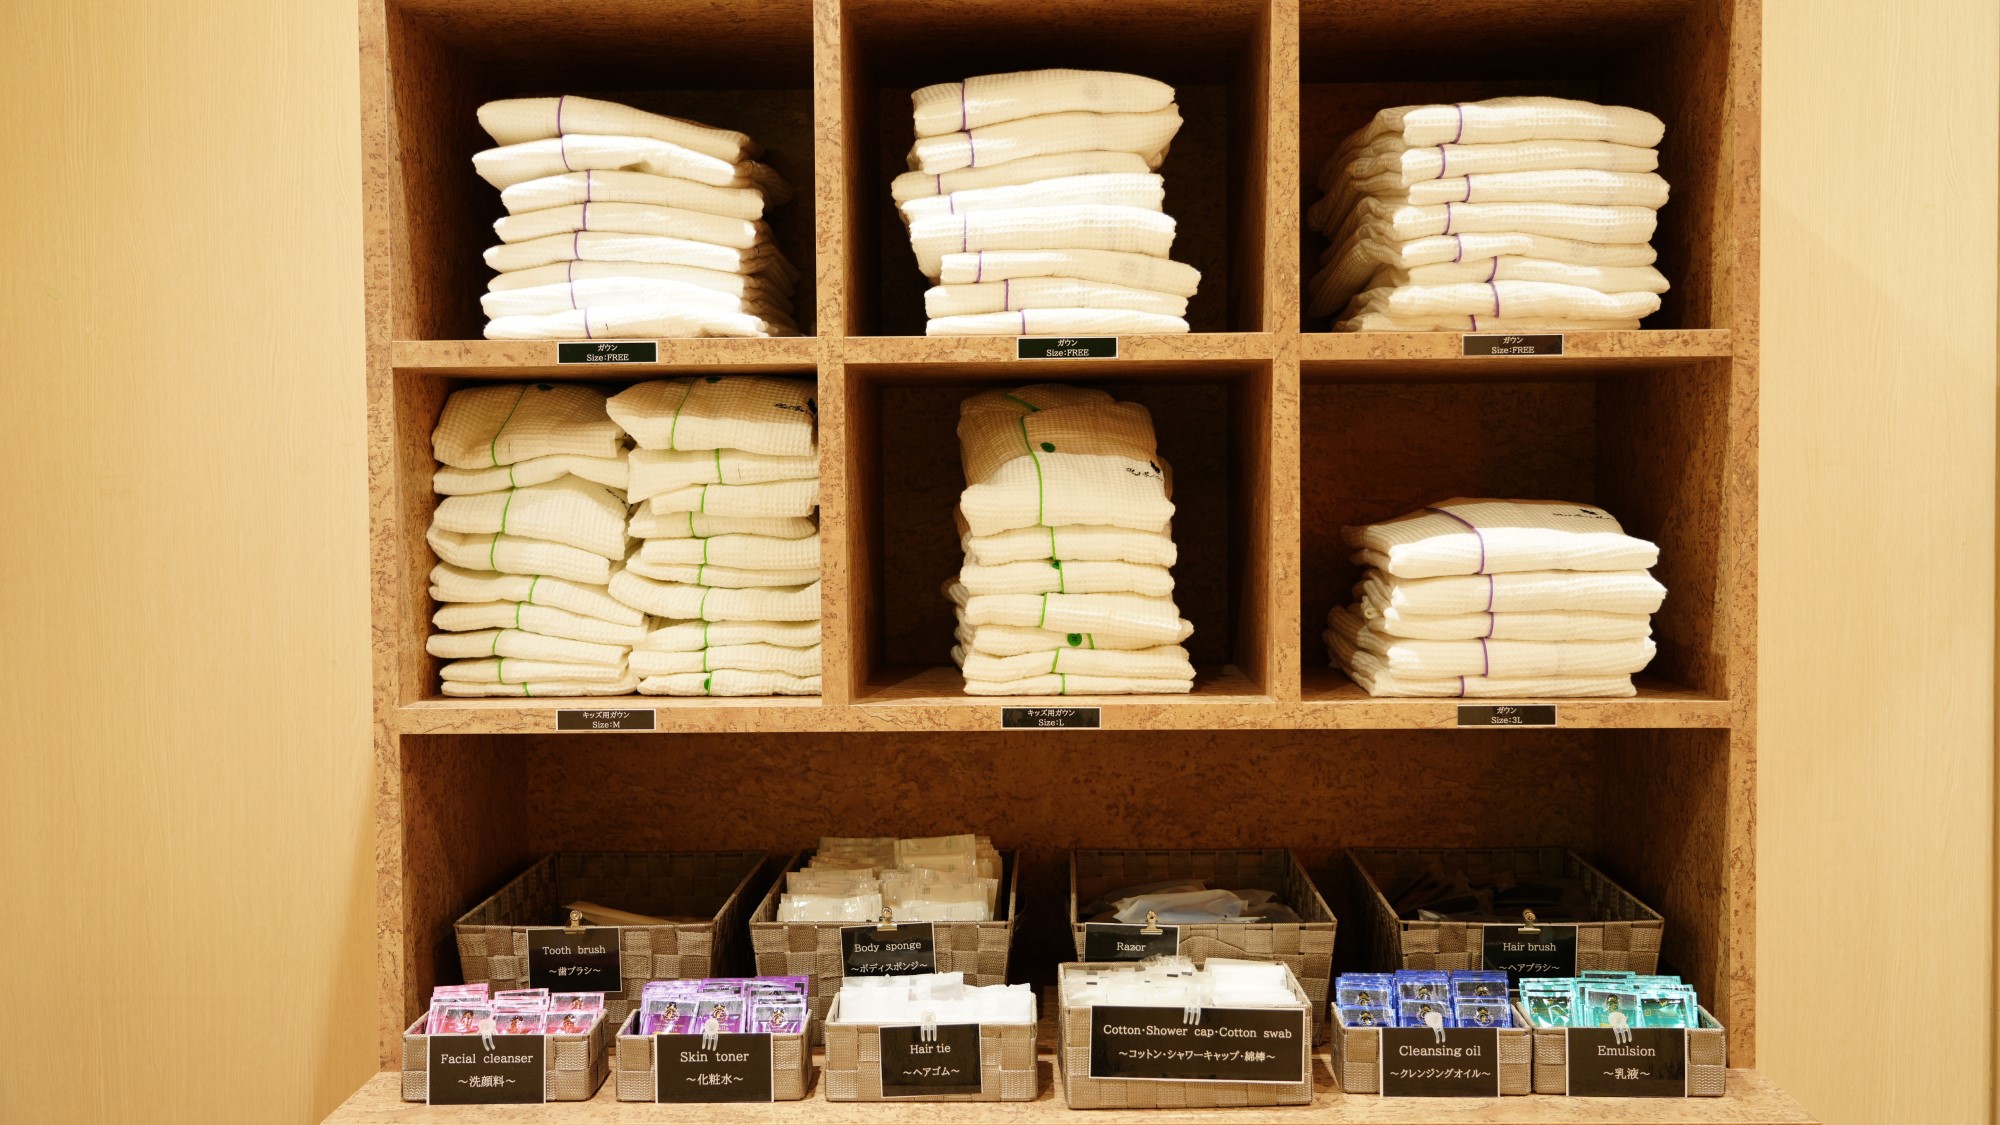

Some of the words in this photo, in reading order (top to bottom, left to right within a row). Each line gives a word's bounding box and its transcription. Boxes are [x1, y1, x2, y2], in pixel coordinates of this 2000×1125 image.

[1057, 339, 1078, 347] ガウン
[1502, 336, 1523, 344] ガウン
[597, 344, 618, 352] ガウン
[1046, 348, 1090, 357] Size:FREE
[1491, 346, 1535, 355] Size:FREE
[586, 353, 630, 362] Size:FREE
[1027, 709, 1075, 717] キッズ用ガウン
[1496, 706, 1517, 714] ガウン
[582, 711, 630, 719] キッズ用ガウン
[592, 720, 621, 729] Size:M
[1038, 718, 1065, 727] Size:L
[1491, 716, 1523, 724] Size:3L
[541, 945, 572, 955] Tooth
[577, 944, 606, 955] brush
[854, 943, 880, 953] Body
[885, 940, 922, 954] sponge
[1116, 941, 1147, 952] Razor
[1502, 941, 1526, 952] Hair
[1528, 941, 1557, 952] brush
[1263, 1028, 1292, 1039] swab
[909, 1042, 934, 1054] Hair
[936, 1042, 951, 1054] tie
[1398, 1044, 1462, 1058] Cleansing
[1465, 1044, 1481, 1057] oil
[1597, 1044, 1656, 1057] Emulsion
[440, 1053, 477, 1064] Facial
[483, 1052, 534, 1064] cleanser
[680, 1050, 708, 1063] Skin
[715, 1051, 750, 1063] toner
